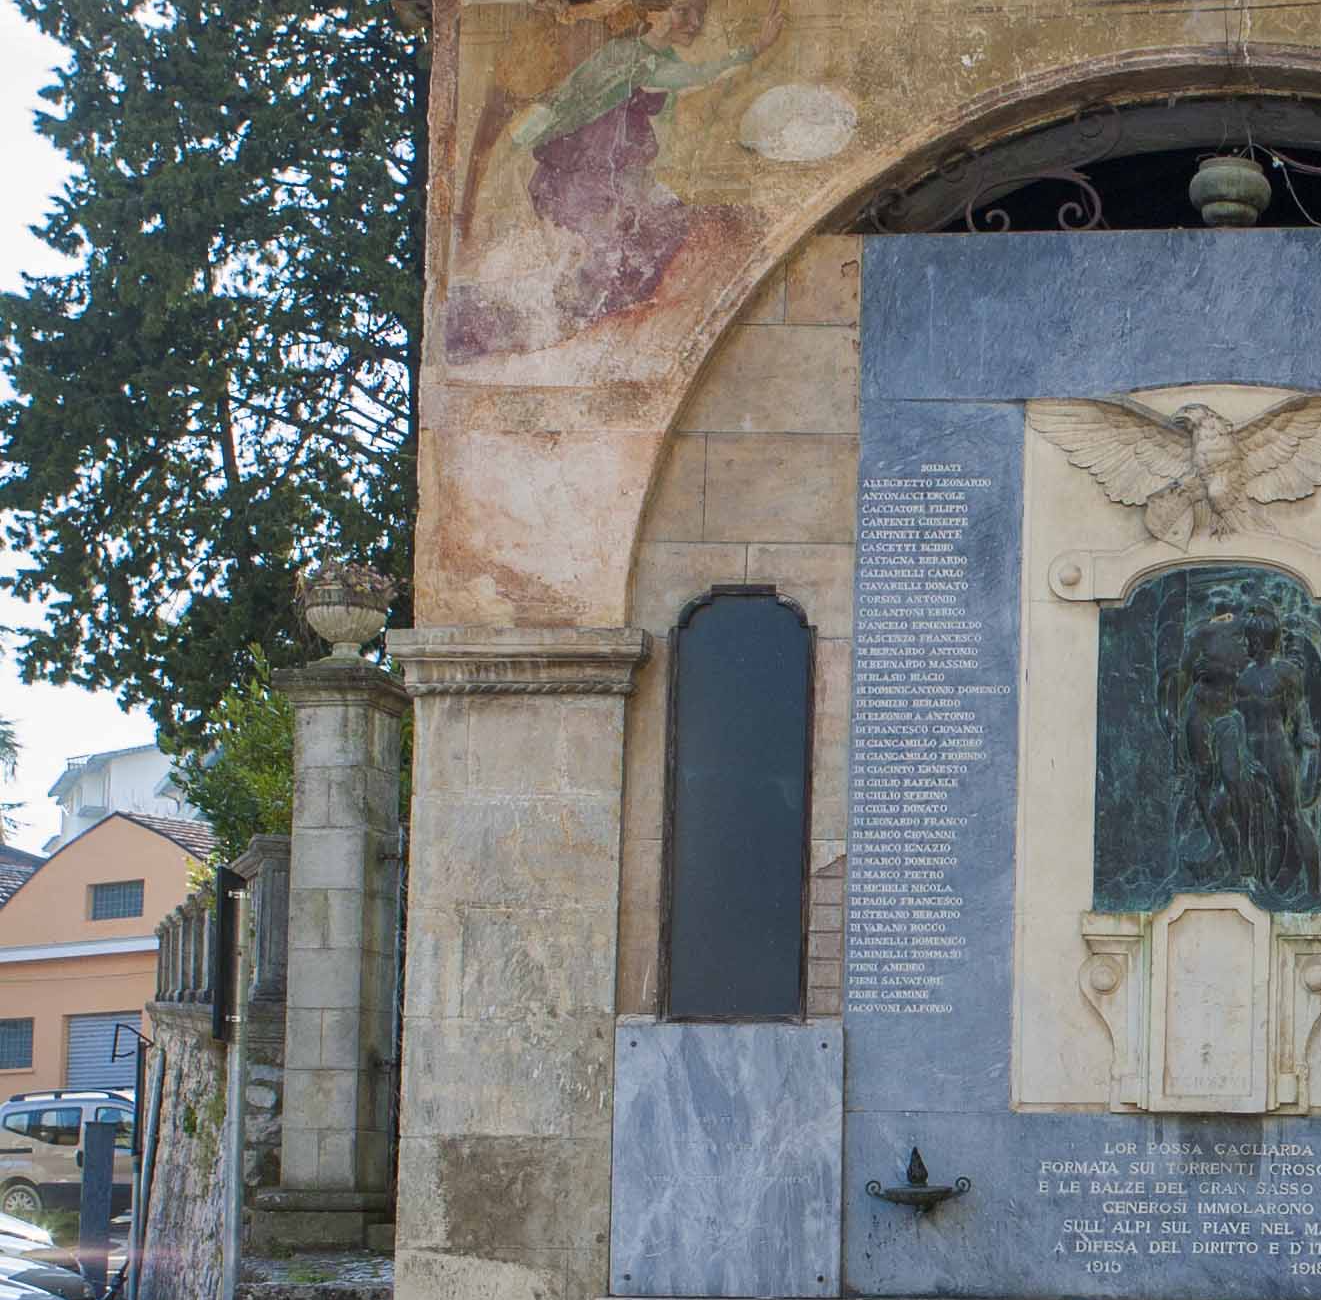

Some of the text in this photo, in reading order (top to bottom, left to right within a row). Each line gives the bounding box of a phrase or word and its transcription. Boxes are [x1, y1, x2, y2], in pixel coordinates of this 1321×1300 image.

[936, 479, 991, 487] LEONARDO
[924, 530, 962, 538] SANTE
[929, 660, 978, 668] MASSIMO
[863, 844, 901, 852] MARCO
[863, 857, 901, 865] MARCO
[904, 857, 957, 865] DOMENICO
[901, 897, 963, 905] FRANCESCO
[1104, 1143, 1136, 1154] LOR
[1148, 1143, 1202, 1154] POSSA
[1041, 1161, 1119, 1173] FORMATA
[1129, 1162, 1154, 1173] SUI
[1167, 1163, 1254, 1175] TORRENTI
[1091, 1182, 1145, 1193] BALZE
[1155, 1183, 1187, 1193] DEL
[1256, 1183, 1312, 1195] SASSO
[1198, 1203, 1314, 1214] IMMOLARONO
[1112, 1222, 1150, 1233] ALPI
[1161, 1222, 1191, 1233] SUL
[1203, 1222, 1250, 1234] PIAVE
[1261, 1223, 1294, 1235] NEL
[1076, 1241, 1137, 1253] DIFESA
[1149, 1242, 1181, 1253] DEL
[1192, 1242, 1258, 1254] DIRITTO
